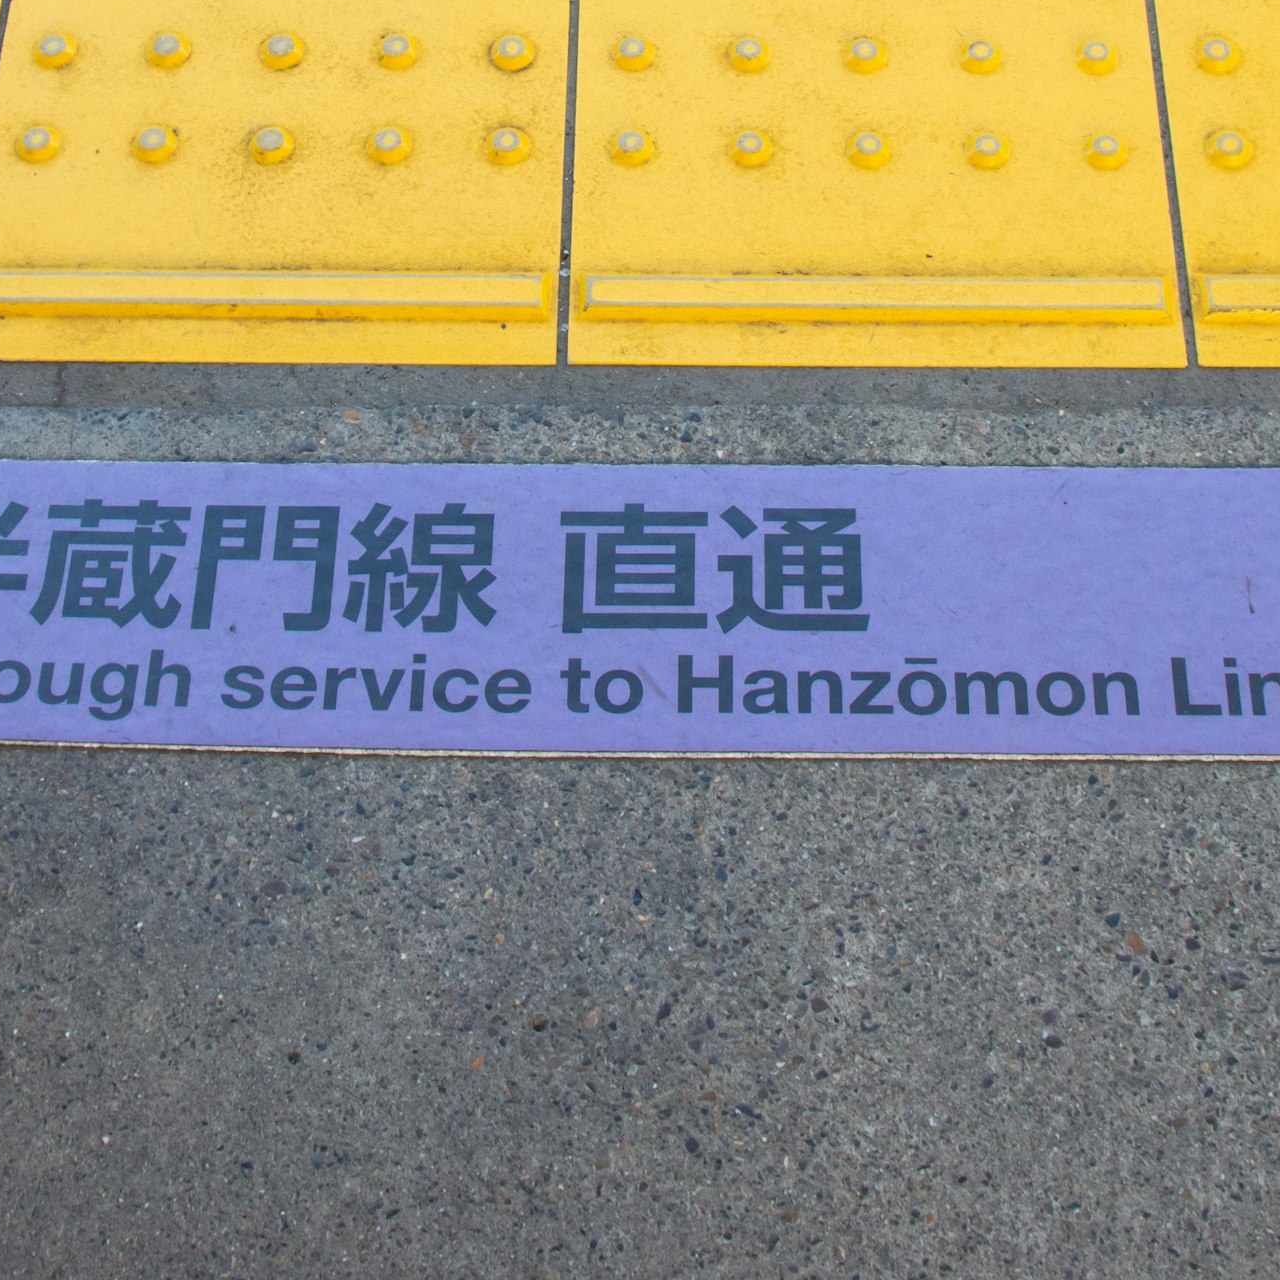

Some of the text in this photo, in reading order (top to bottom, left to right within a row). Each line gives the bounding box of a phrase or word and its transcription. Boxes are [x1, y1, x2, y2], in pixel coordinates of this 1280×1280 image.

[560, 503, 870, 634] 直通
[221, 654, 531, 714] service
[560, 658, 643, 714] to
[678, 655, 1140, 716] Hanzōmon
